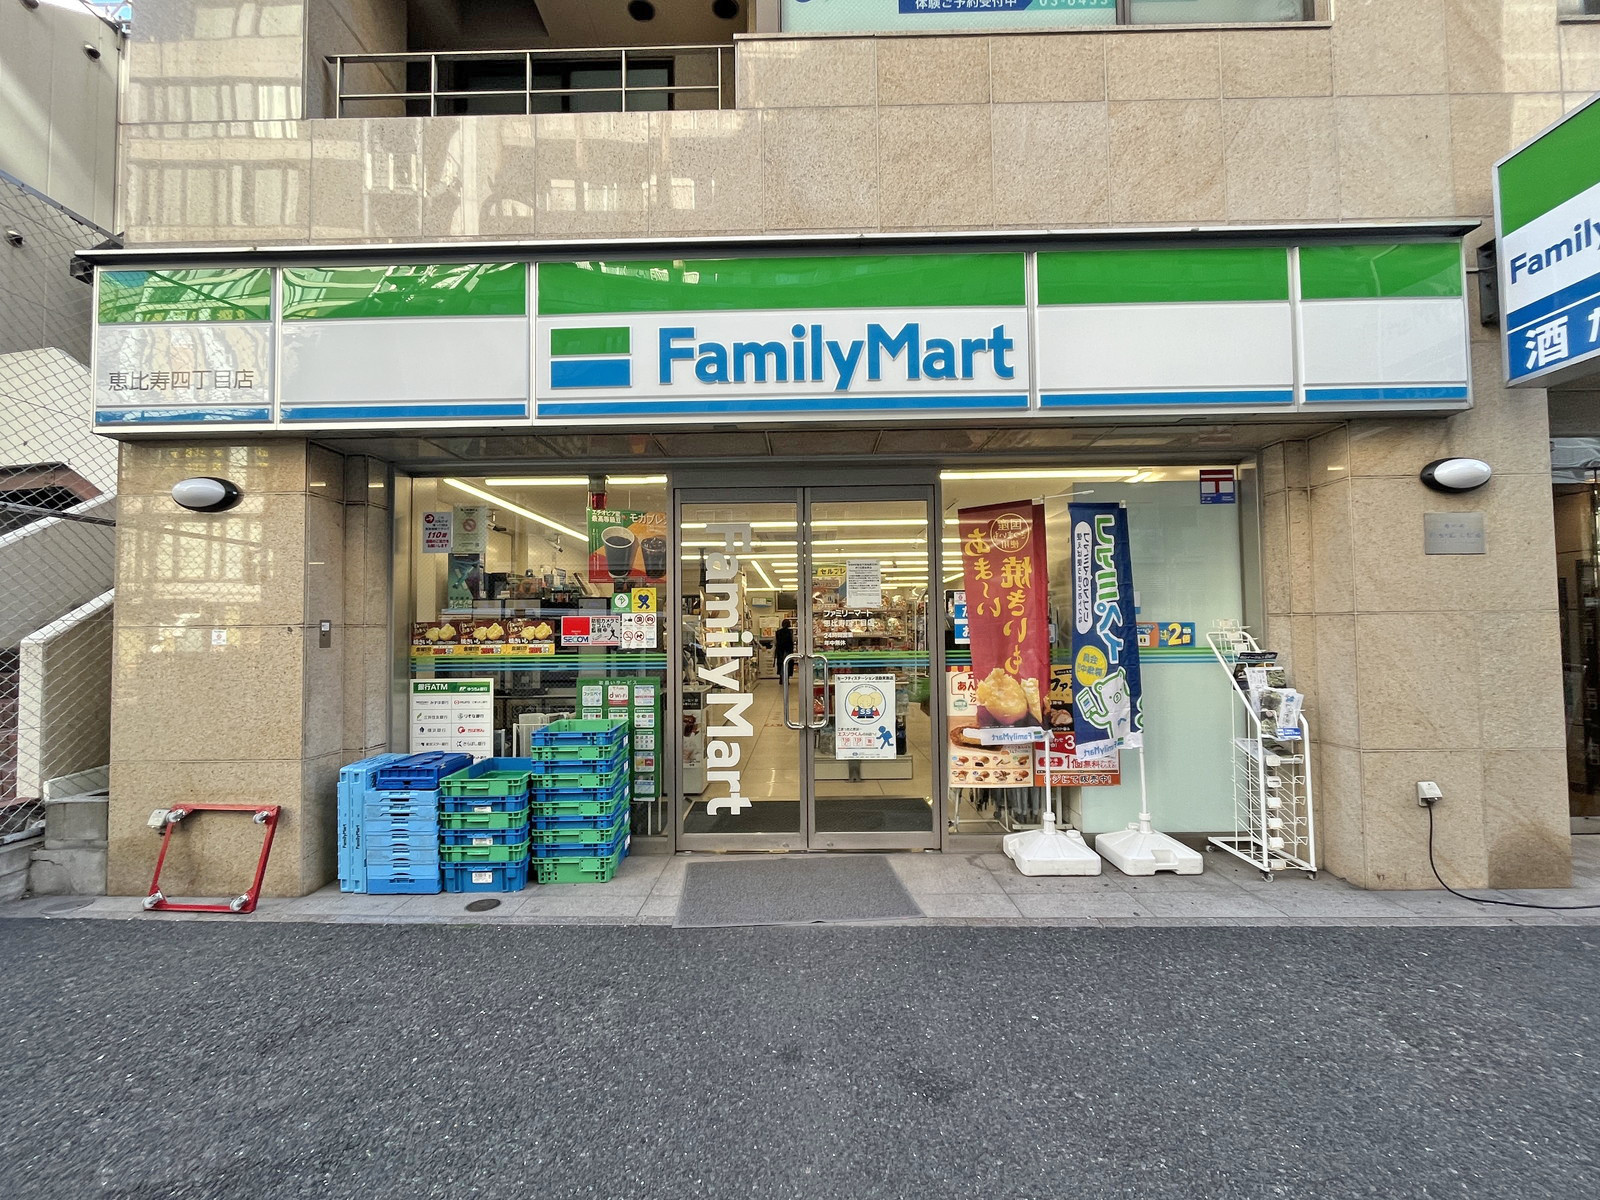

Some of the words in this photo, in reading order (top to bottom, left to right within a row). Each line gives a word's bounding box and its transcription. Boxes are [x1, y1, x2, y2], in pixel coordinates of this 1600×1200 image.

[659, 323, 1015, 391] FamilyMart
[1525, 316, 1568, 369] 酒
[108, 370, 254, 391] 恵比寿四丁目店
[824, 609, 873, 617] ファミリーマート
[417, 683, 448, 691] 銀行ATM
[698, 523, 753, 816] FamilyMart
